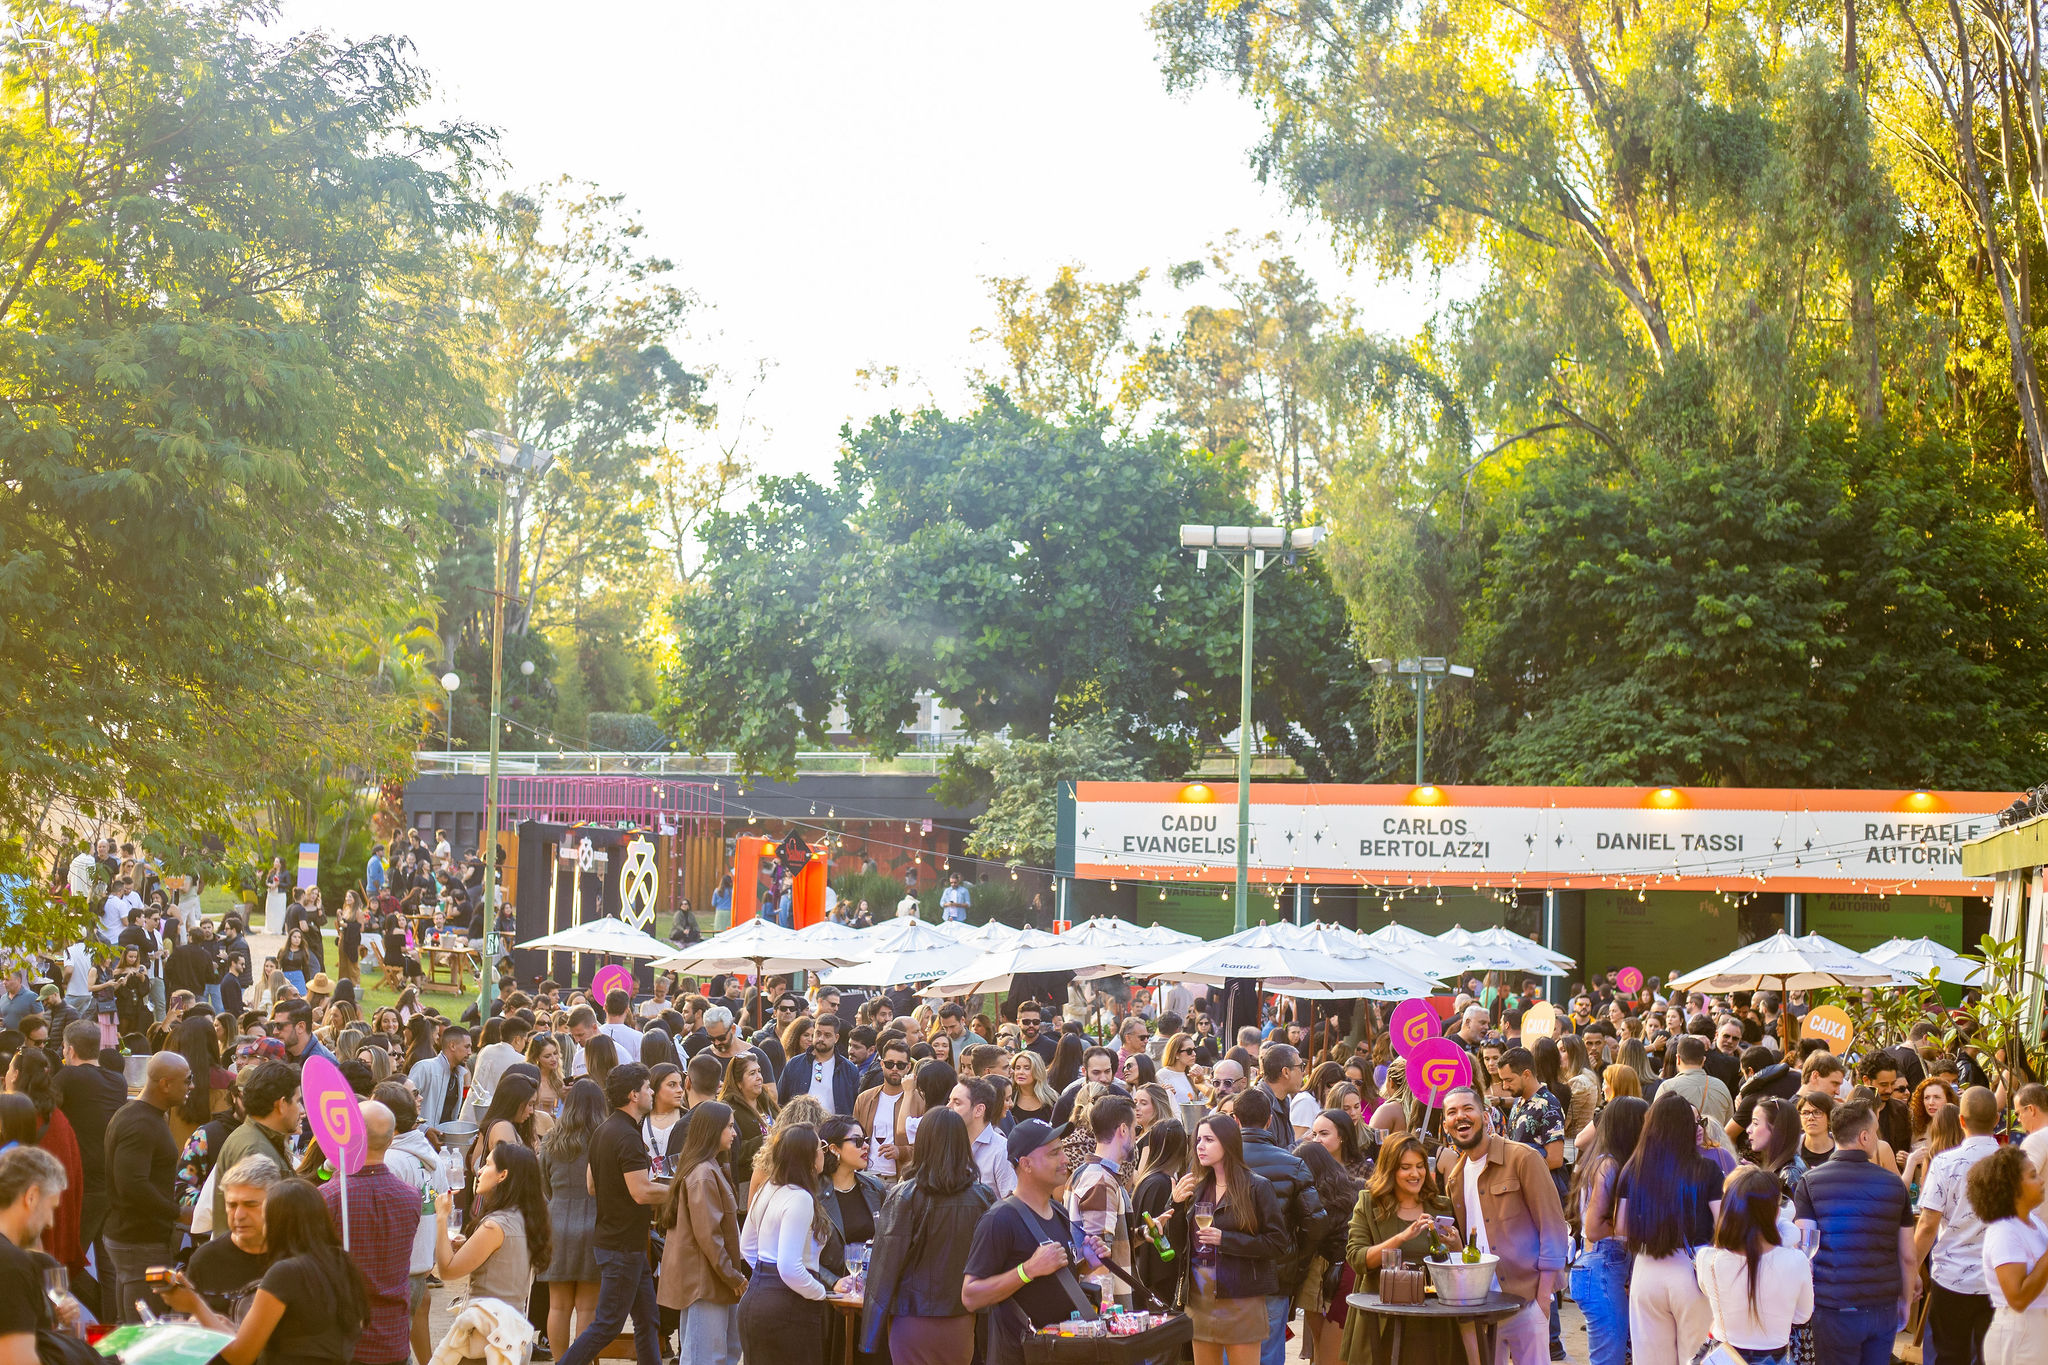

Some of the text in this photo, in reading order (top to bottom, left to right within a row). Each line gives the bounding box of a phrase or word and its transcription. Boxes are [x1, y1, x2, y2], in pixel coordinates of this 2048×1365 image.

[1161, 815, 1217, 832] CADU
[1383, 818, 1467, 836] CARLOS
[1865, 823, 1981, 842] RAFFAELE
[1123, 836, 1255, 854] EVANGELISI
[1360, 840, 1490, 859] BERTOLAZZI
[1597, 832, 1744, 852] DANIEL TASSI
[1866, 846, 1962, 865] AUTORIN
[1809, 1014, 1847, 1041] CAIXA
